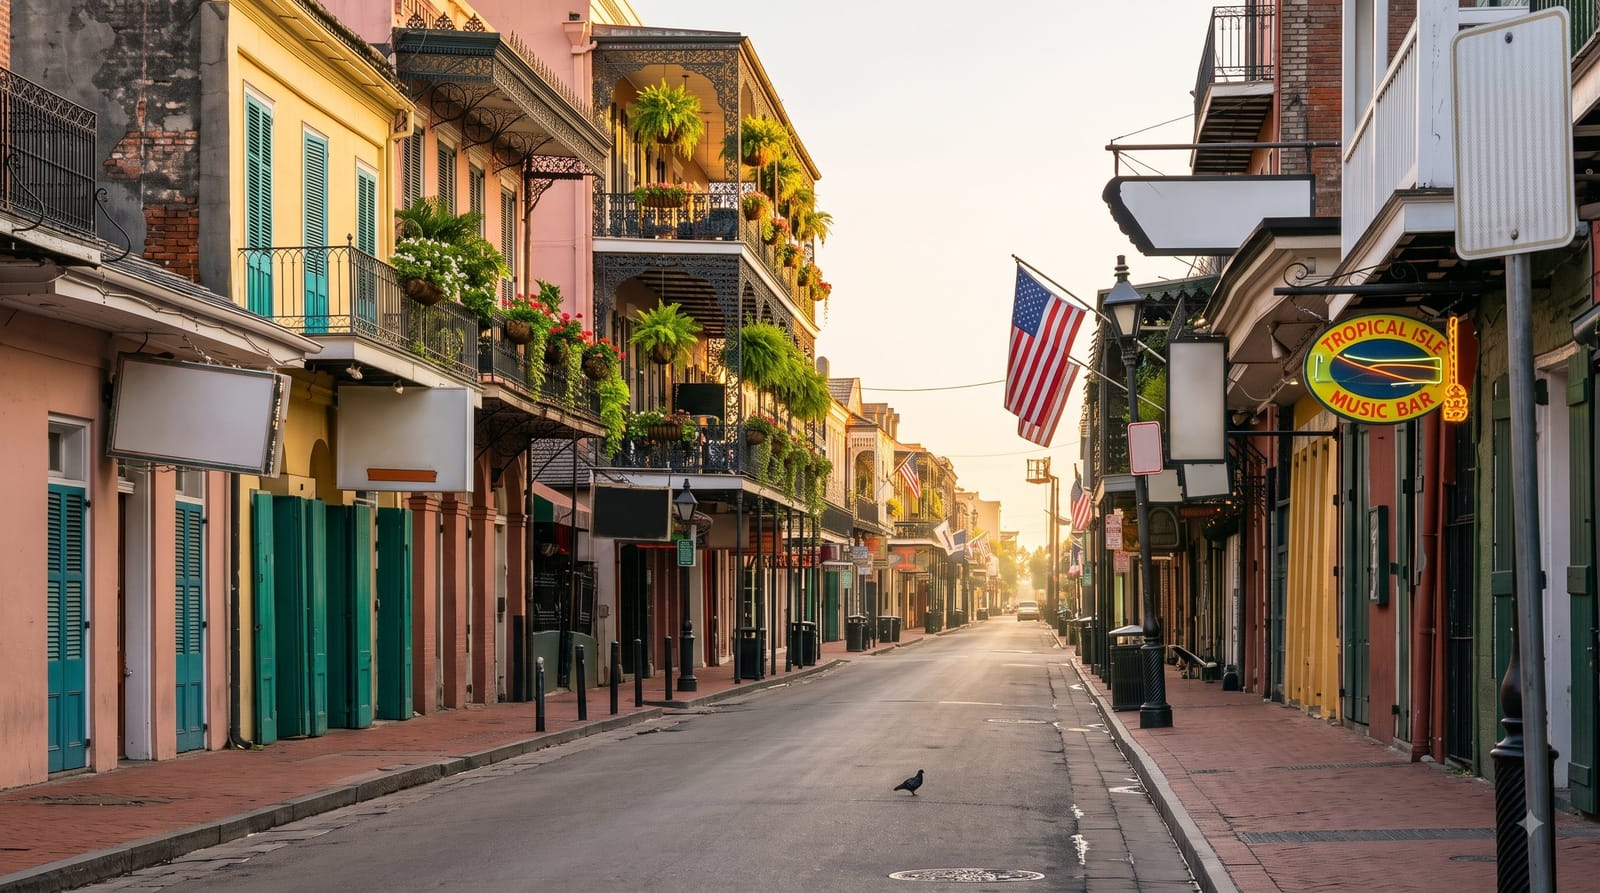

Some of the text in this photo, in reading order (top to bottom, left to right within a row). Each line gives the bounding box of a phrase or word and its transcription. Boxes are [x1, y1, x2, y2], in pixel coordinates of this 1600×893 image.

[1321, 320, 1447, 355] TROPICAL ISLE
[1330, 390, 1436, 418] MUSIC BAR
